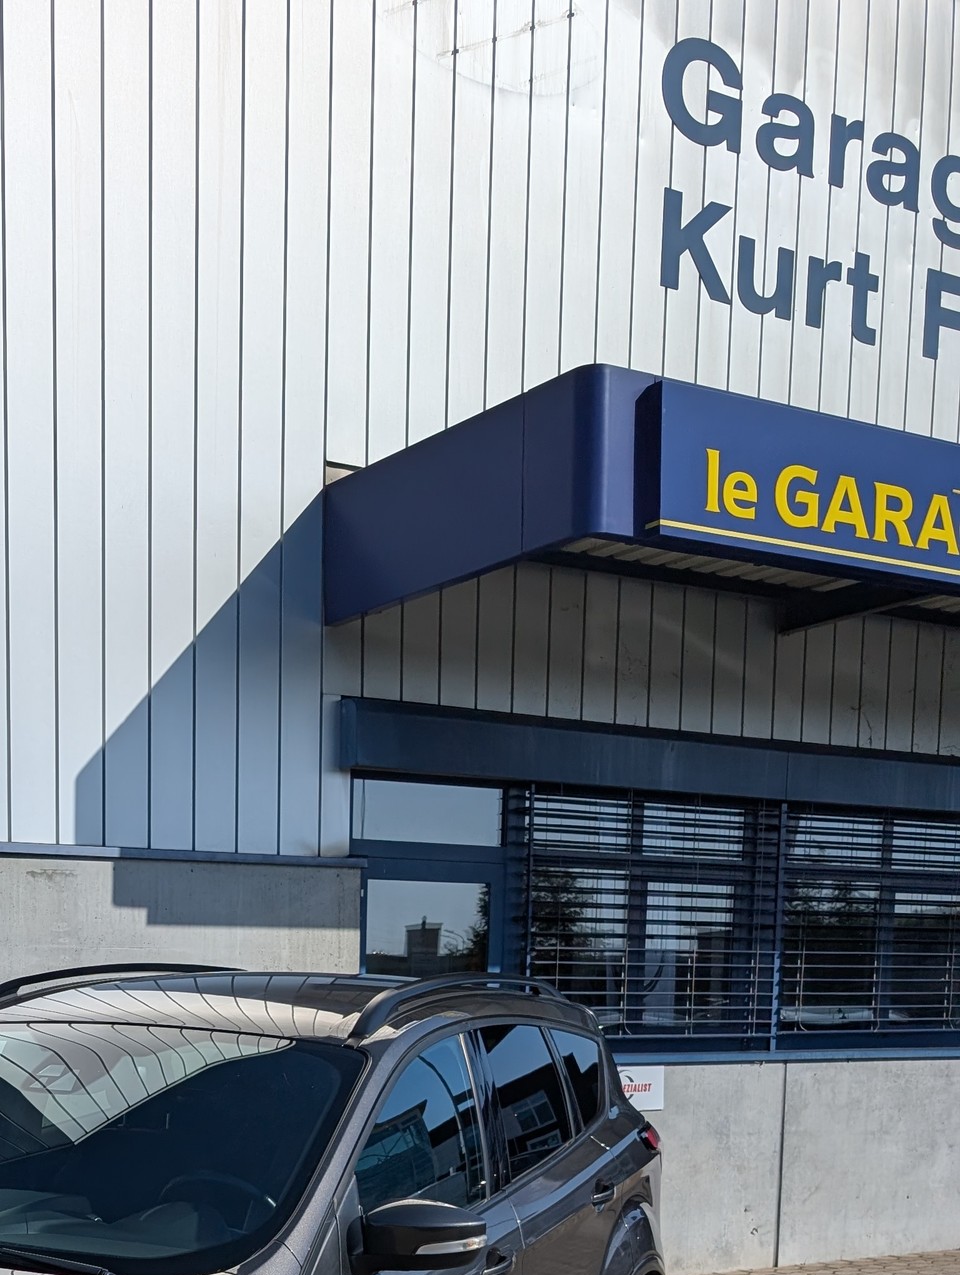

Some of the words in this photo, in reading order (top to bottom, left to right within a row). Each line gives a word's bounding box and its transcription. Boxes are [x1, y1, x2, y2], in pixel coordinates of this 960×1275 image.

[660, 187, 879, 346] Kurt
[705, 448, 758, 520] le
[623, 1083, 652, 1093] EZIALIST
